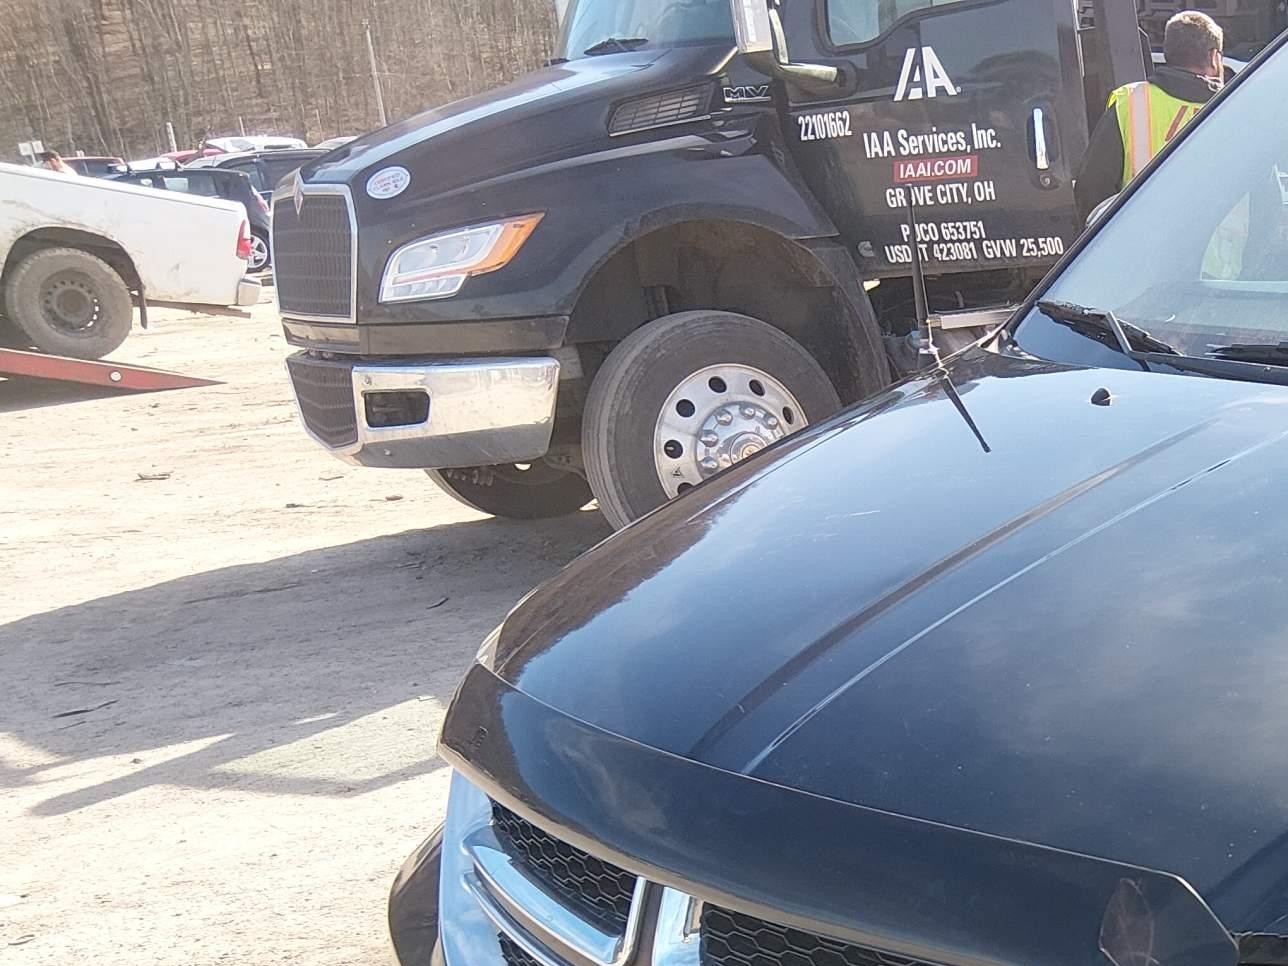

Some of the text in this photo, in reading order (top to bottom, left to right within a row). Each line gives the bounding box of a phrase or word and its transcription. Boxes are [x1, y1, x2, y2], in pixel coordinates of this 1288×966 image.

[723, 85, 768, 99] MV
[798, 111, 852, 141] 22101662
[863, 123, 1001, 159] IAA Services, Inc.
[899, 159, 971, 179] IAAI.COM
[936, 183, 971, 204] CITY,
[974, 181, 996, 201] OH
[941, 220, 986, 241] 653751
[934, 242, 978, 261] 423081
[983, 239, 1017, 259] GVW
[1020, 237, 1064, 258] 25,500
